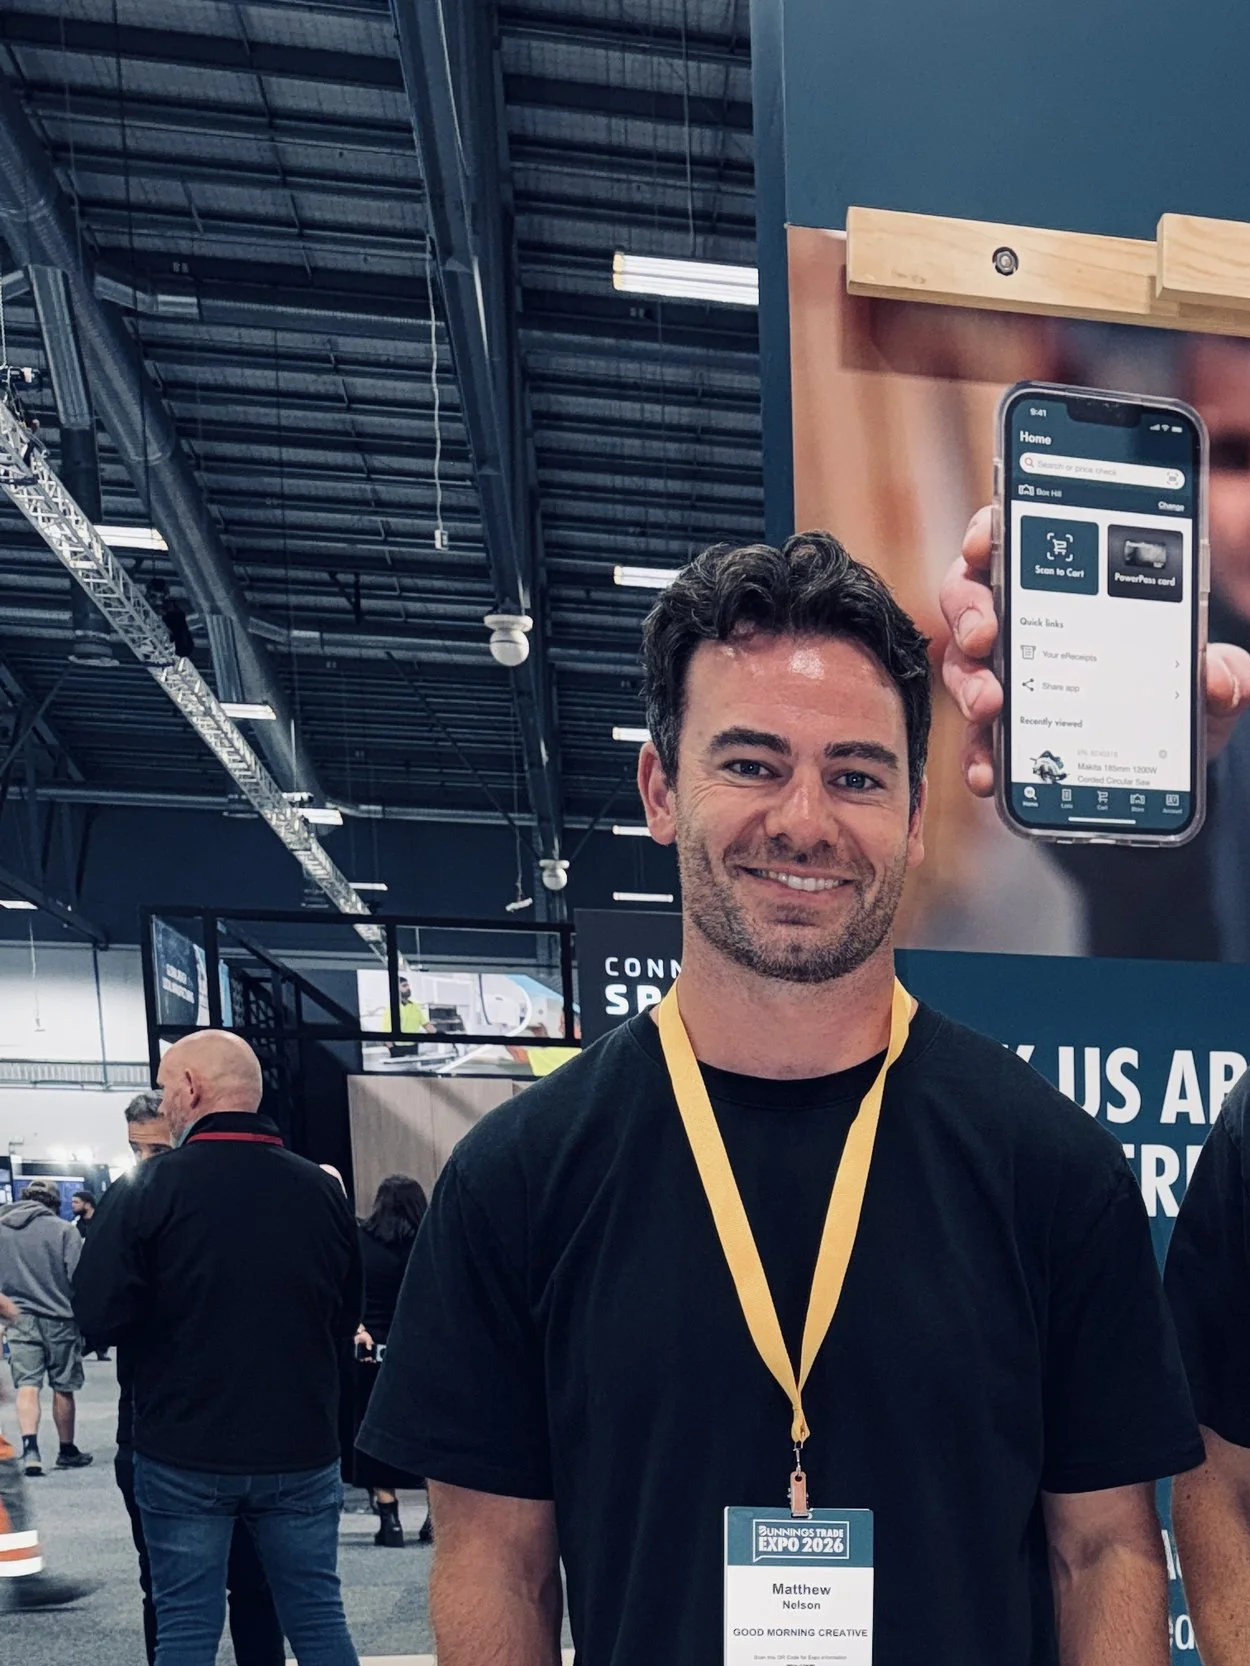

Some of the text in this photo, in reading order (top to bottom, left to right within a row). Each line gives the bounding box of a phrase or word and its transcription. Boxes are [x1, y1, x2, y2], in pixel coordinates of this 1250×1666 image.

[1030, 408, 1047, 417] 9:41
[1020, 430, 1052, 445] Home
[1158, 501, 1185, 512] Change
[1034, 565, 1085, 578] Scan to Cart
[1114, 572, 1176, 587] PowerPass card
[1020, 617, 1064, 629] Quick links
[1020, 716, 1083, 728] Recently viewed
[605, 956, 681, 979] CONN
[605, 983, 662, 1015] SP
[1058, 1046, 1142, 1125] US
[758, 1525, 844, 1538] BUNNINGS TRADE
[758, 1537, 844, 1553] EXPO 2026
[772, 1583, 832, 1596] Matthew
[782, 1600, 821, 1610] Nelson
[733, 1628, 868, 1637] GOOD MORNING CREATIVE
